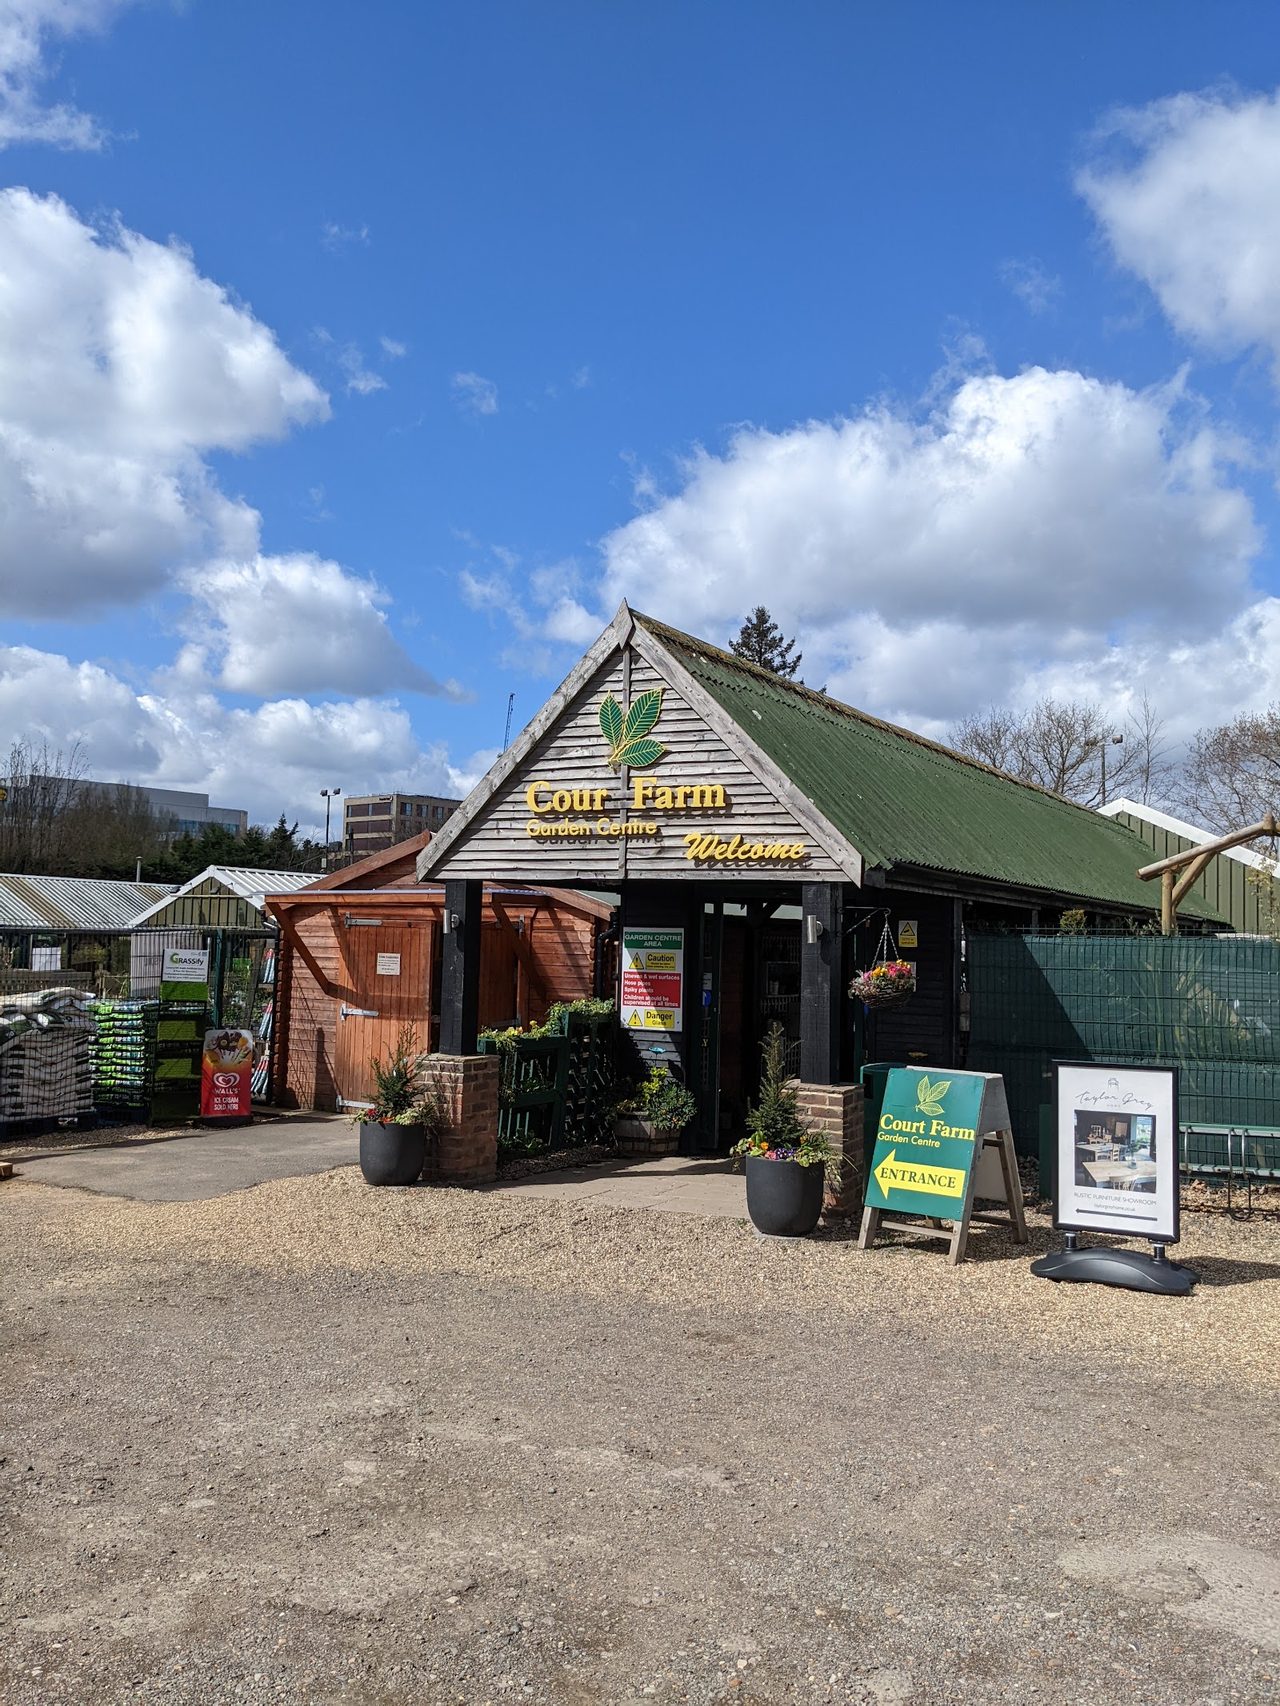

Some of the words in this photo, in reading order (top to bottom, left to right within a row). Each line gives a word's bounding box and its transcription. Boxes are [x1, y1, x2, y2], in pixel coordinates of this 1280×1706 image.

[525, 781, 608, 812] Cour
[631, 777, 726, 810] Farm
[526, 818, 590, 836] Garden
[596, 818, 658, 835] Centre
[683, 832, 806, 861] Welcome
[647, 953, 675, 962] Caution
[646, 1011, 672, 1021] Danger
[880, 1114, 926, 1134] Court
[930, 1119, 975, 1141] Farm
[877, 1131, 908, 1143] Garden
[910, 1135, 941, 1148] Centre
[880, 1167, 957, 1189] ENTRANCE
[1092, 1194, 1122, 1202] FURNITURE
[1122, 1196, 1157, 1206] SHOWROOM
